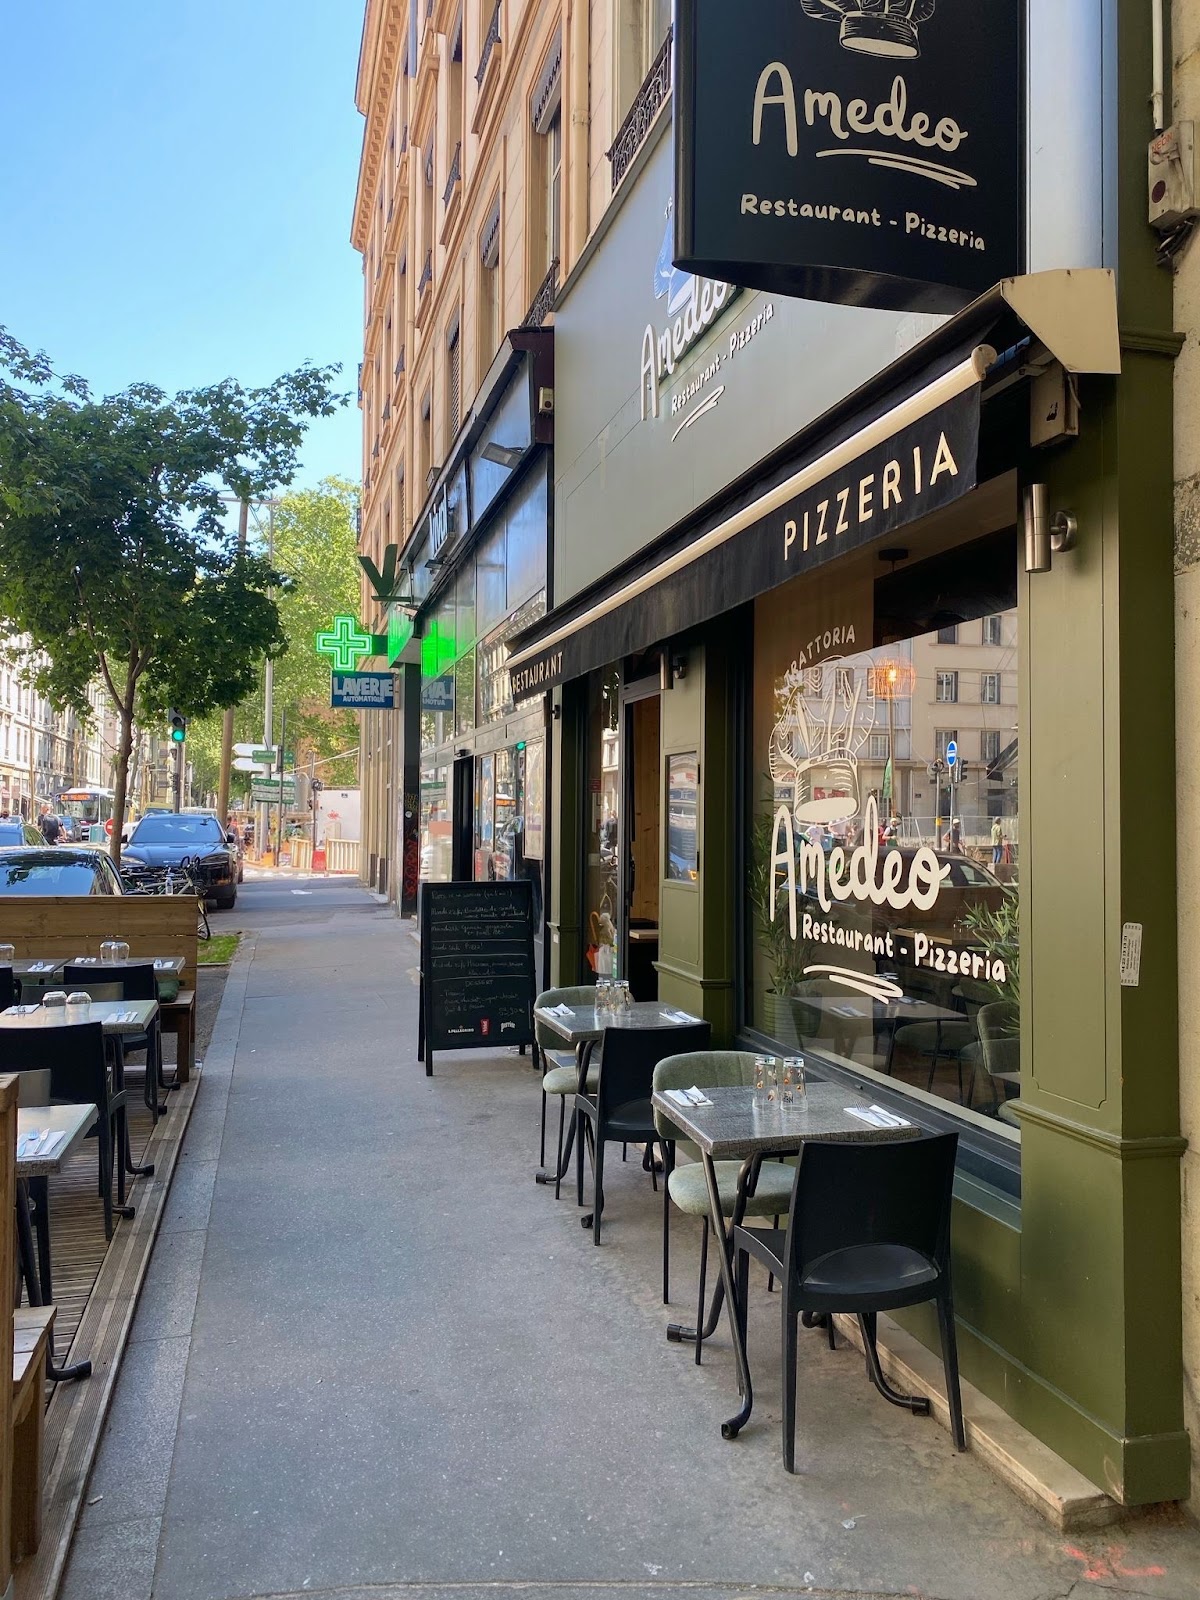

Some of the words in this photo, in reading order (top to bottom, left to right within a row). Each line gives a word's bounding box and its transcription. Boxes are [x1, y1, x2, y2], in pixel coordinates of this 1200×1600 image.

[752, 61, 968, 158] Amedeo
[740, 193, 882, 228] Restaurant
[905, 211, 986, 252] Pizzeria
[671, 353, 721, 417] Restaurant
[729, 302, 774, 360] Pizzeria
[783, 431, 958, 561] PIZZERIA
[332, 676, 394, 699] LAVERIE
[784, 624, 856, 688] TRATTORIA
[342, 695, 386, 703] AUTOMATIQUE
[769, 794, 951, 941] Amedeo
[801, 912, 894, 959] Restaurant
[914, 932, 1007, 984] Pizzeria
